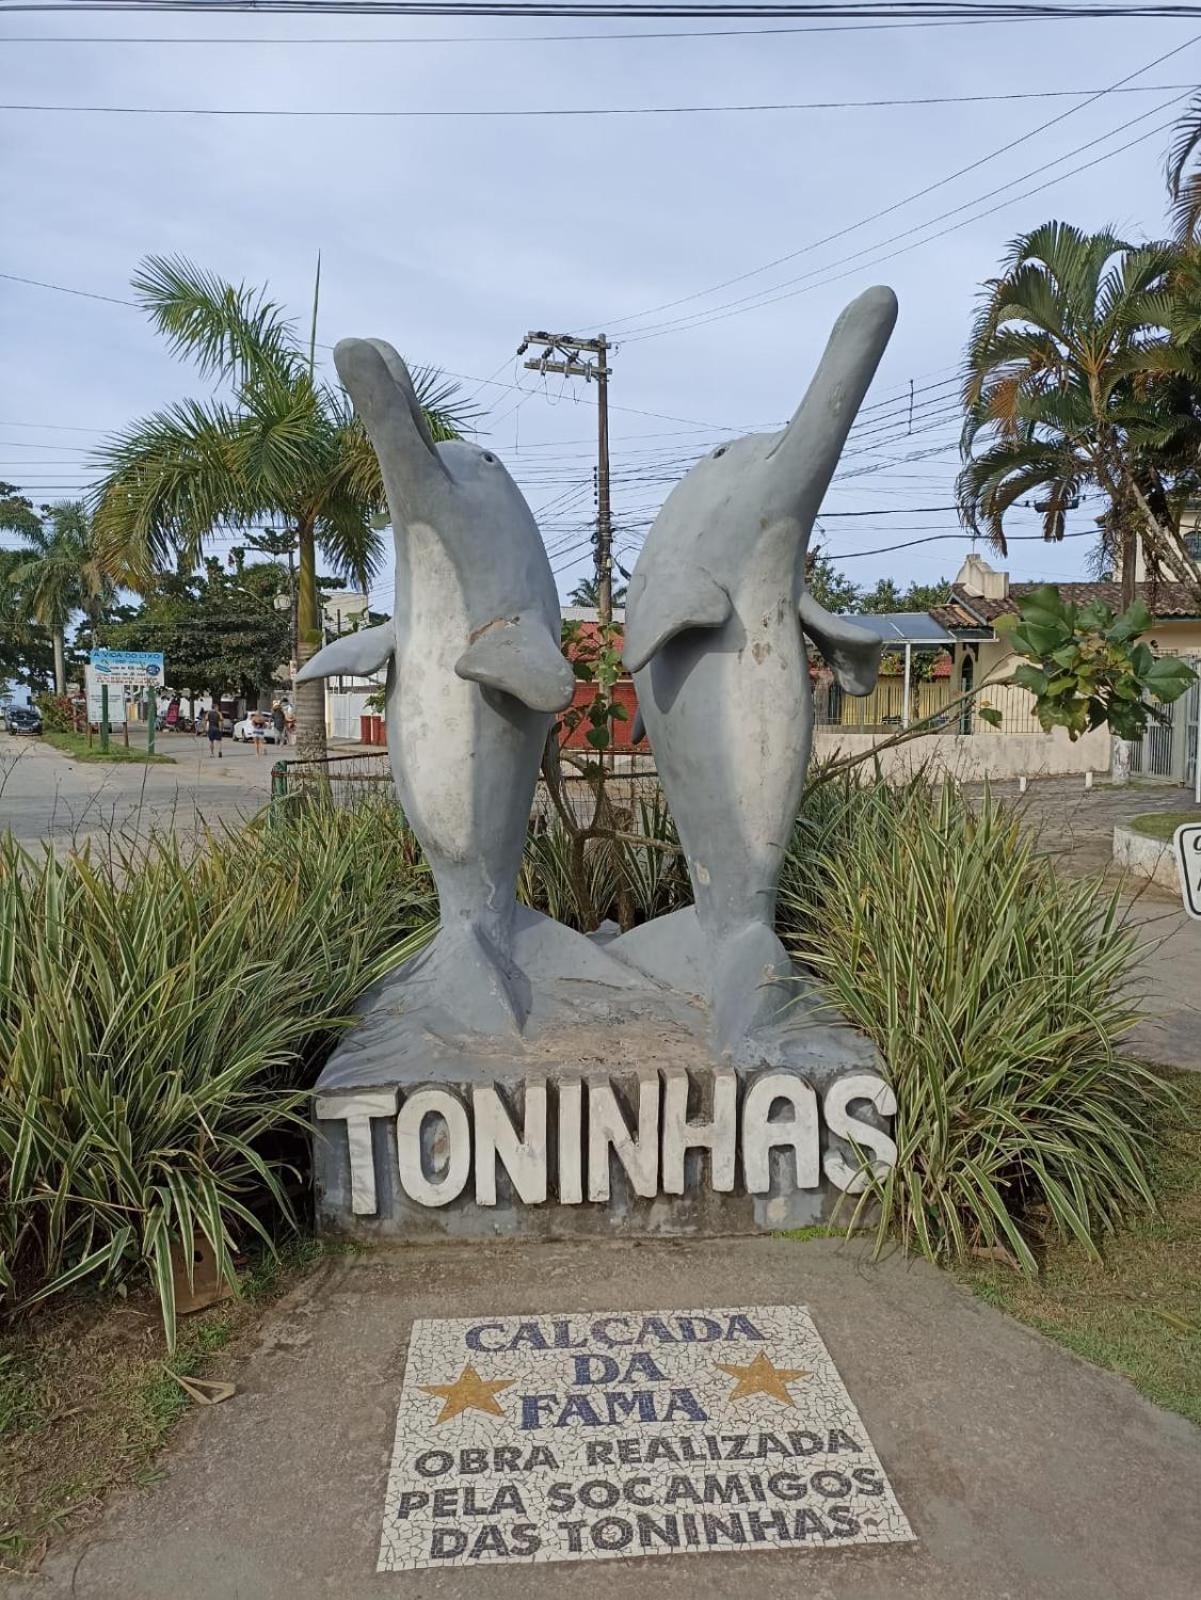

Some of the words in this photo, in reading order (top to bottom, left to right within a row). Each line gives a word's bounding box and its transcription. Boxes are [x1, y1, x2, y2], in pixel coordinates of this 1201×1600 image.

[315, 1070, 898, 1215] TONINHAS
[570, 1352, 667, 1386] DA
[519, 1388, 708, 1430] FAMA
[414, 1445, 560, 1478] OBRA
[586, 1428, 864, 1467] REALIZADA
[397, 1485, 527, 1520] PELA
[547, 1467, 885, 1513] SOCAMIGOS
[430, 1522, 542, 1560] DAS
[558, 1505, 862, 1553] TONINHAS
